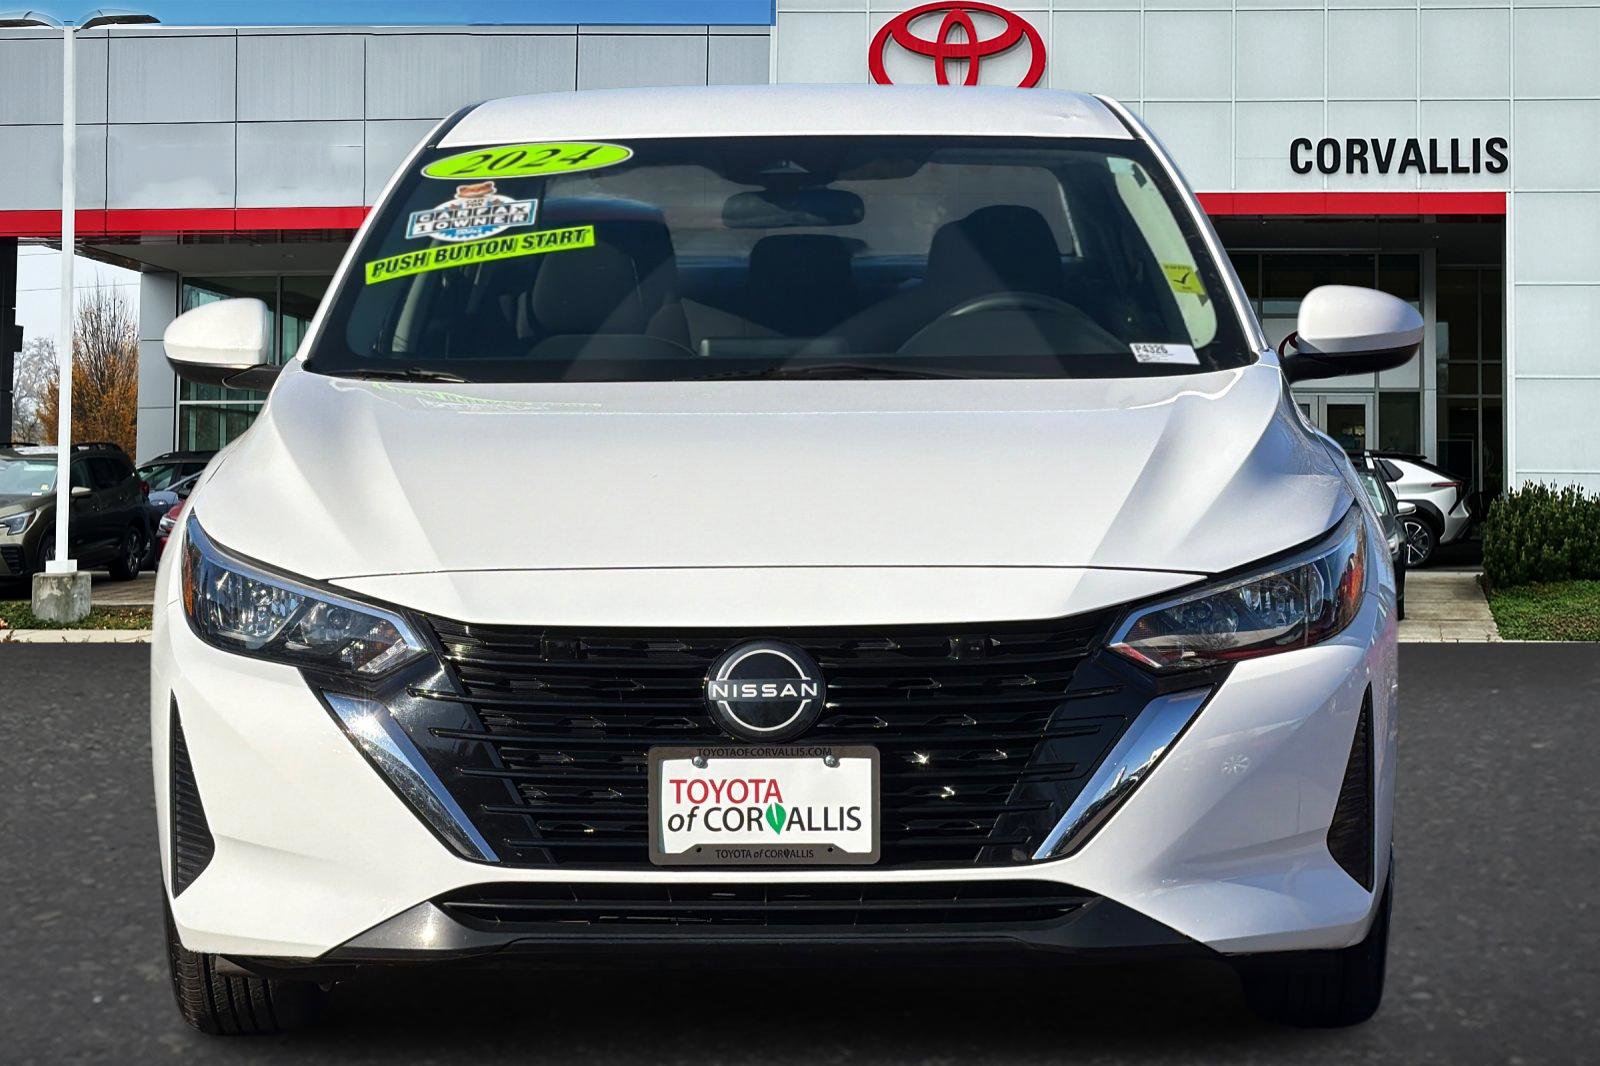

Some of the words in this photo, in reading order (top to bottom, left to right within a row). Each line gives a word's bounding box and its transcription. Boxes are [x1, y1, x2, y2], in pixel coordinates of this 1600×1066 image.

[451, 145, 603, 175] 2024
[1290, 137, 1509, 174] CORVALLIS
[419, 205, 528, 223] CARFAX
[435, 214, 527, 230] OWNER
[371, 250, 428, 278] PUSH
[434, 237, 518, 264] BUTTON
[522, 228, 587, 250] START
[711, 682, 818, 698] NISSAN
[697, 747, 832, 758] TOYOTAOFCORVALLIS.COM
[669, 778, 784, 804] TOYOTA
[667, 805, 700, 832] of
[715, 849, 752, 859] TOYOTA
[753, 849, 765, 859] of
